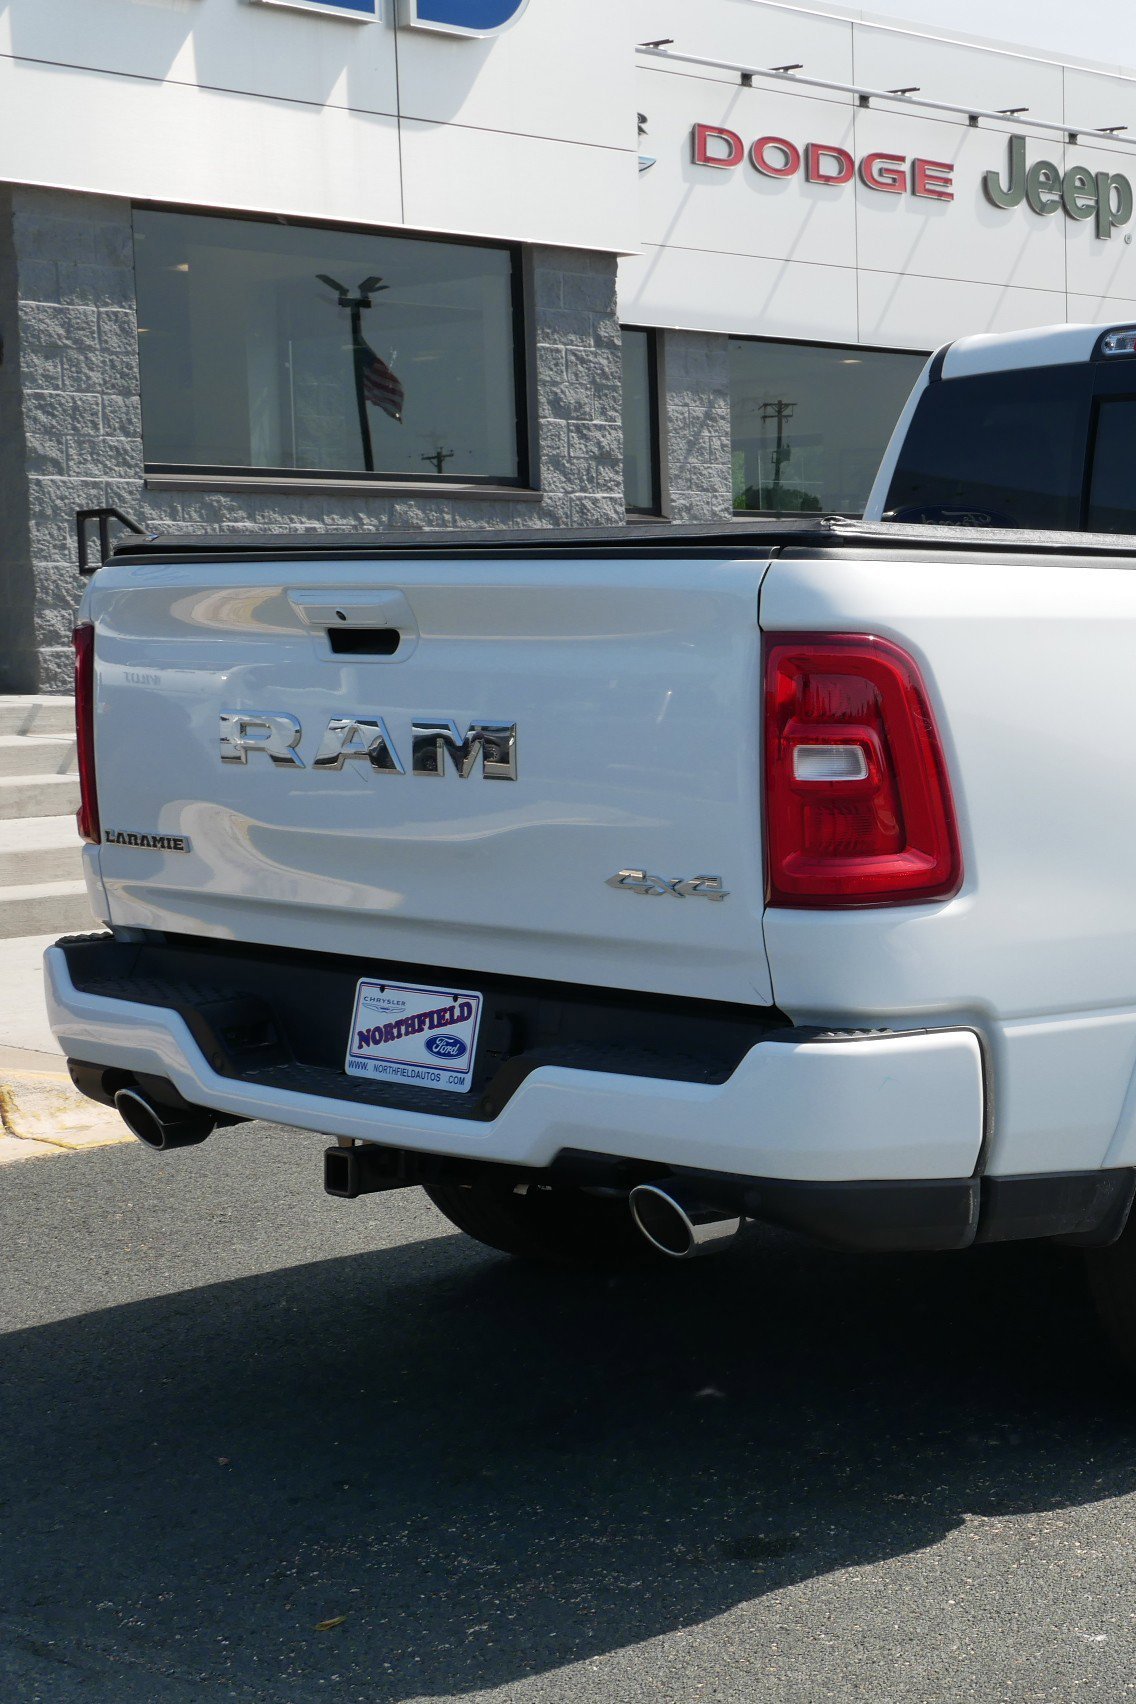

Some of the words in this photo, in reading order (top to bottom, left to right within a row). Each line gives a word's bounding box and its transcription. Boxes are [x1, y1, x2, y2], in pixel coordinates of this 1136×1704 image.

[691, 122, 955, 202] DODGE
[983, 135, 1133, 239] Jeep
[219, 709, 517, 781] RAM
[104, 829, 186, 851] LARAMIE
[604, 868, 730, 902] 4x4
[363, 996, 407, 1006] CHRYSLER
[357, 1001, 473, 1049] NORTHFIELD
[432, 1037, 459, 1055] Ford
[349, 1060, 369, 1071] WWW.
[373, 1063, 441, 1082] NORTHFIELDAUTOS
[446, 1075, 466, 1086] .COM
